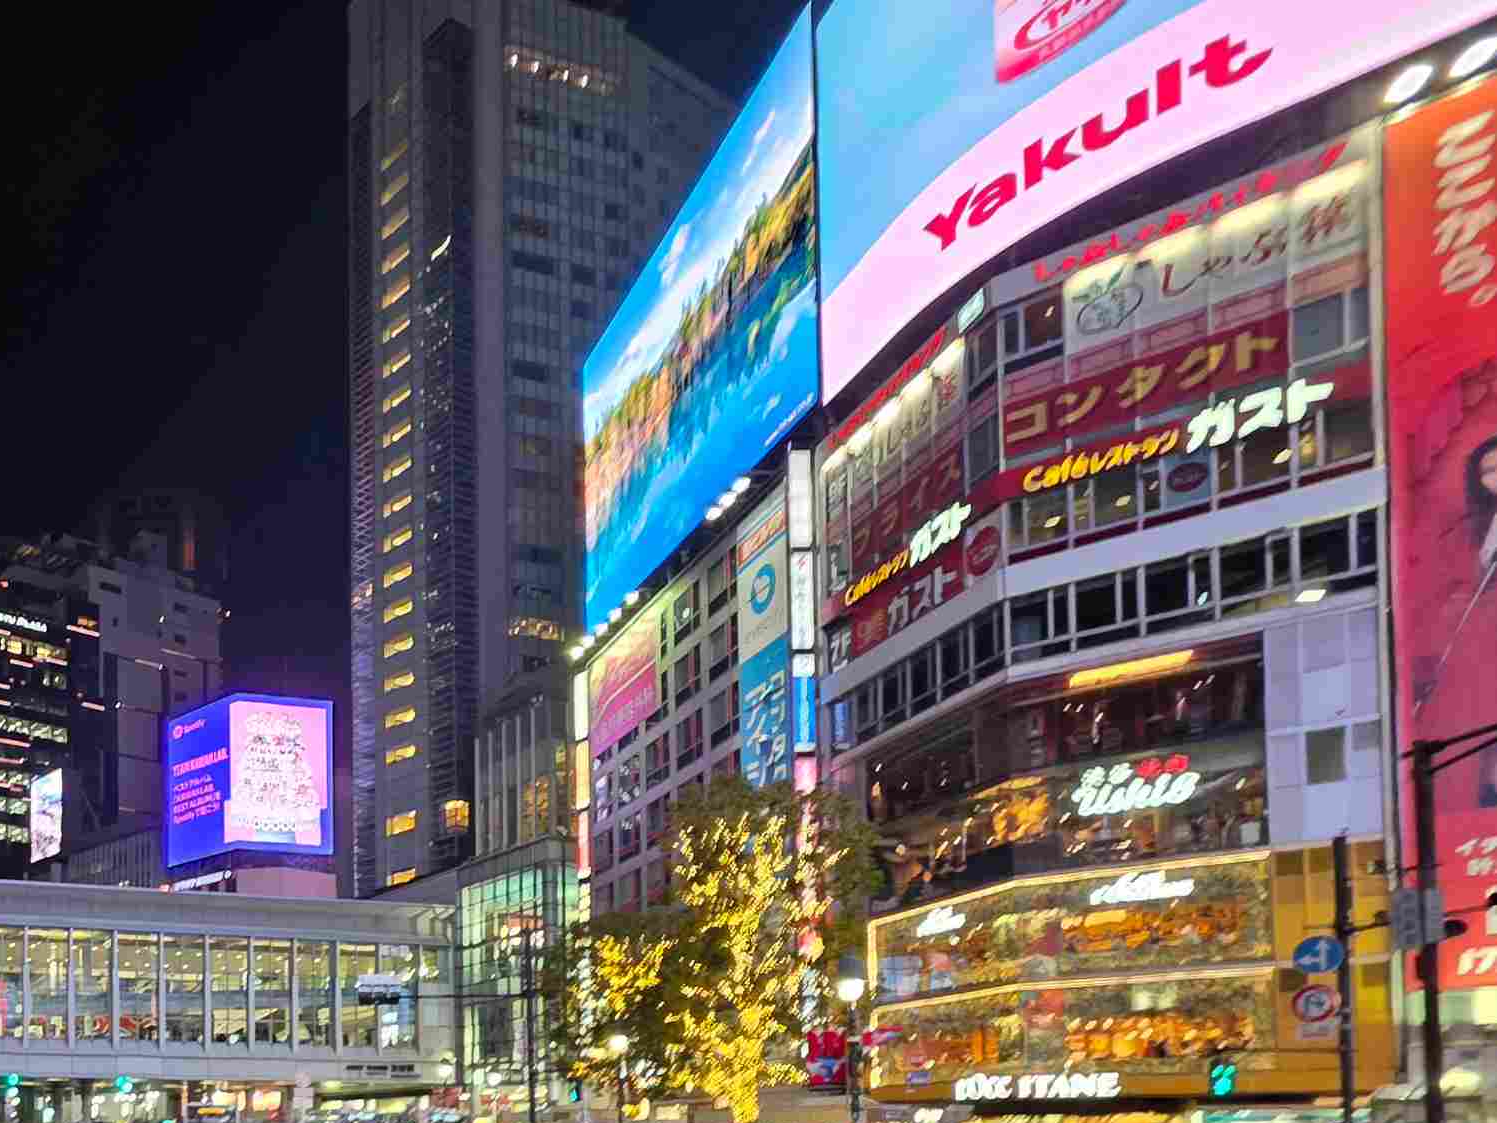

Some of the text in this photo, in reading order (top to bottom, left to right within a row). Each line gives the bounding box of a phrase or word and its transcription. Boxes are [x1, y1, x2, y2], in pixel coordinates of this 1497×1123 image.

[923, 33, 1272, 251] Yakult
[1005, 331, 1278, 443] コンタクト
[1185, 378, 1335, 454] ガスト
